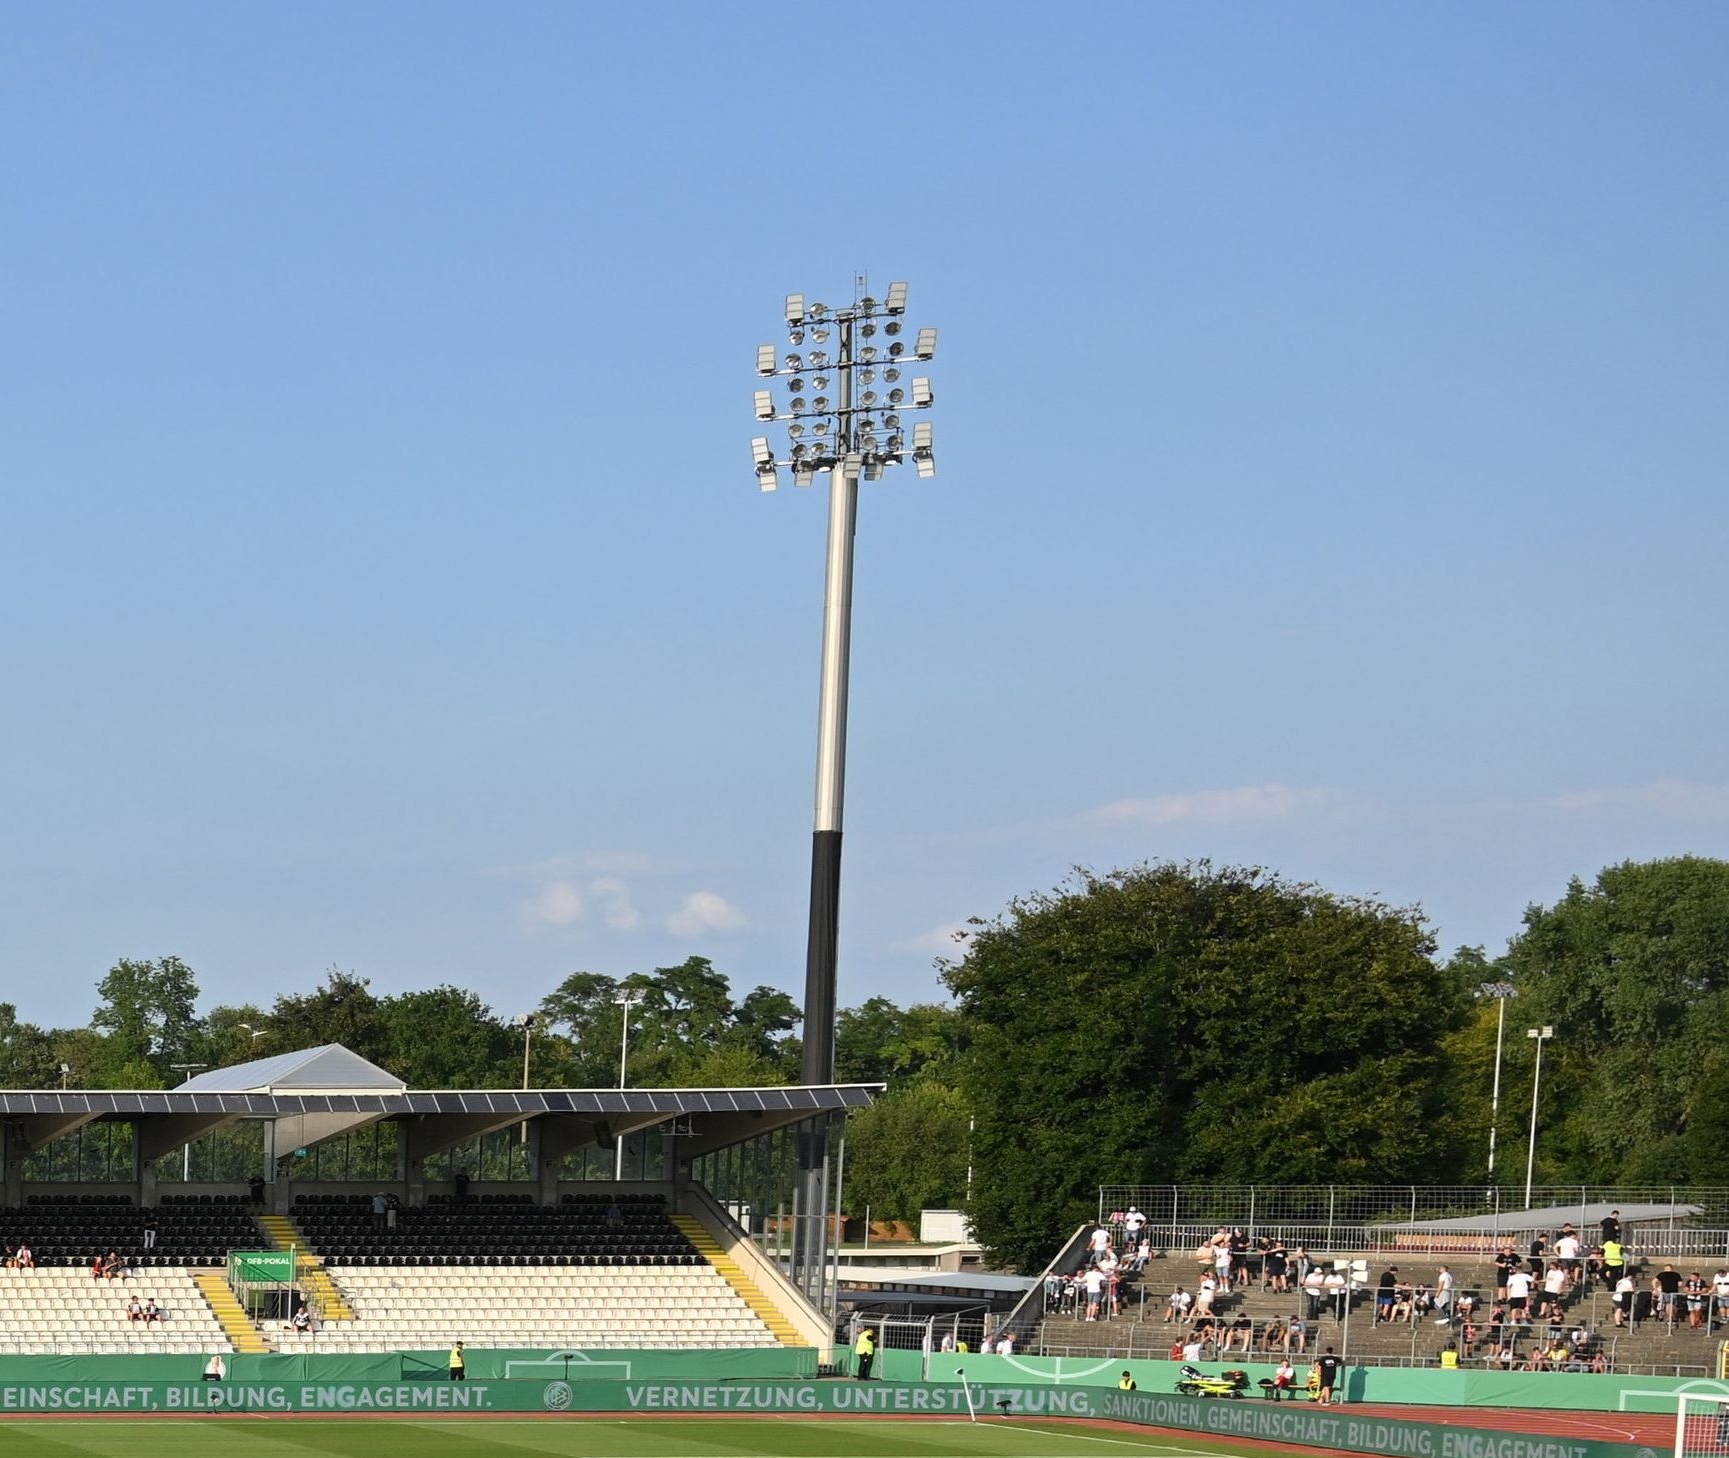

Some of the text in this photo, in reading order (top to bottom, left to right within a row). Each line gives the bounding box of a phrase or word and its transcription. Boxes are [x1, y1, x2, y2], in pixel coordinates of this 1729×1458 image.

[166, 1386, 293, 1411] BILDUNG,
[300, 1385, 492, 1408] ENGAGEMENT.
[625, 1386, 824, 1411] VERNETZUNG,
[832, 1382, 1096, 1416] UNTERSTÜTZUNG,
[1103, 1393, 1204, 1430] SANKTIONEN,
[1206, 1405, 1342, 1448] GEMEINSCHAFT,
